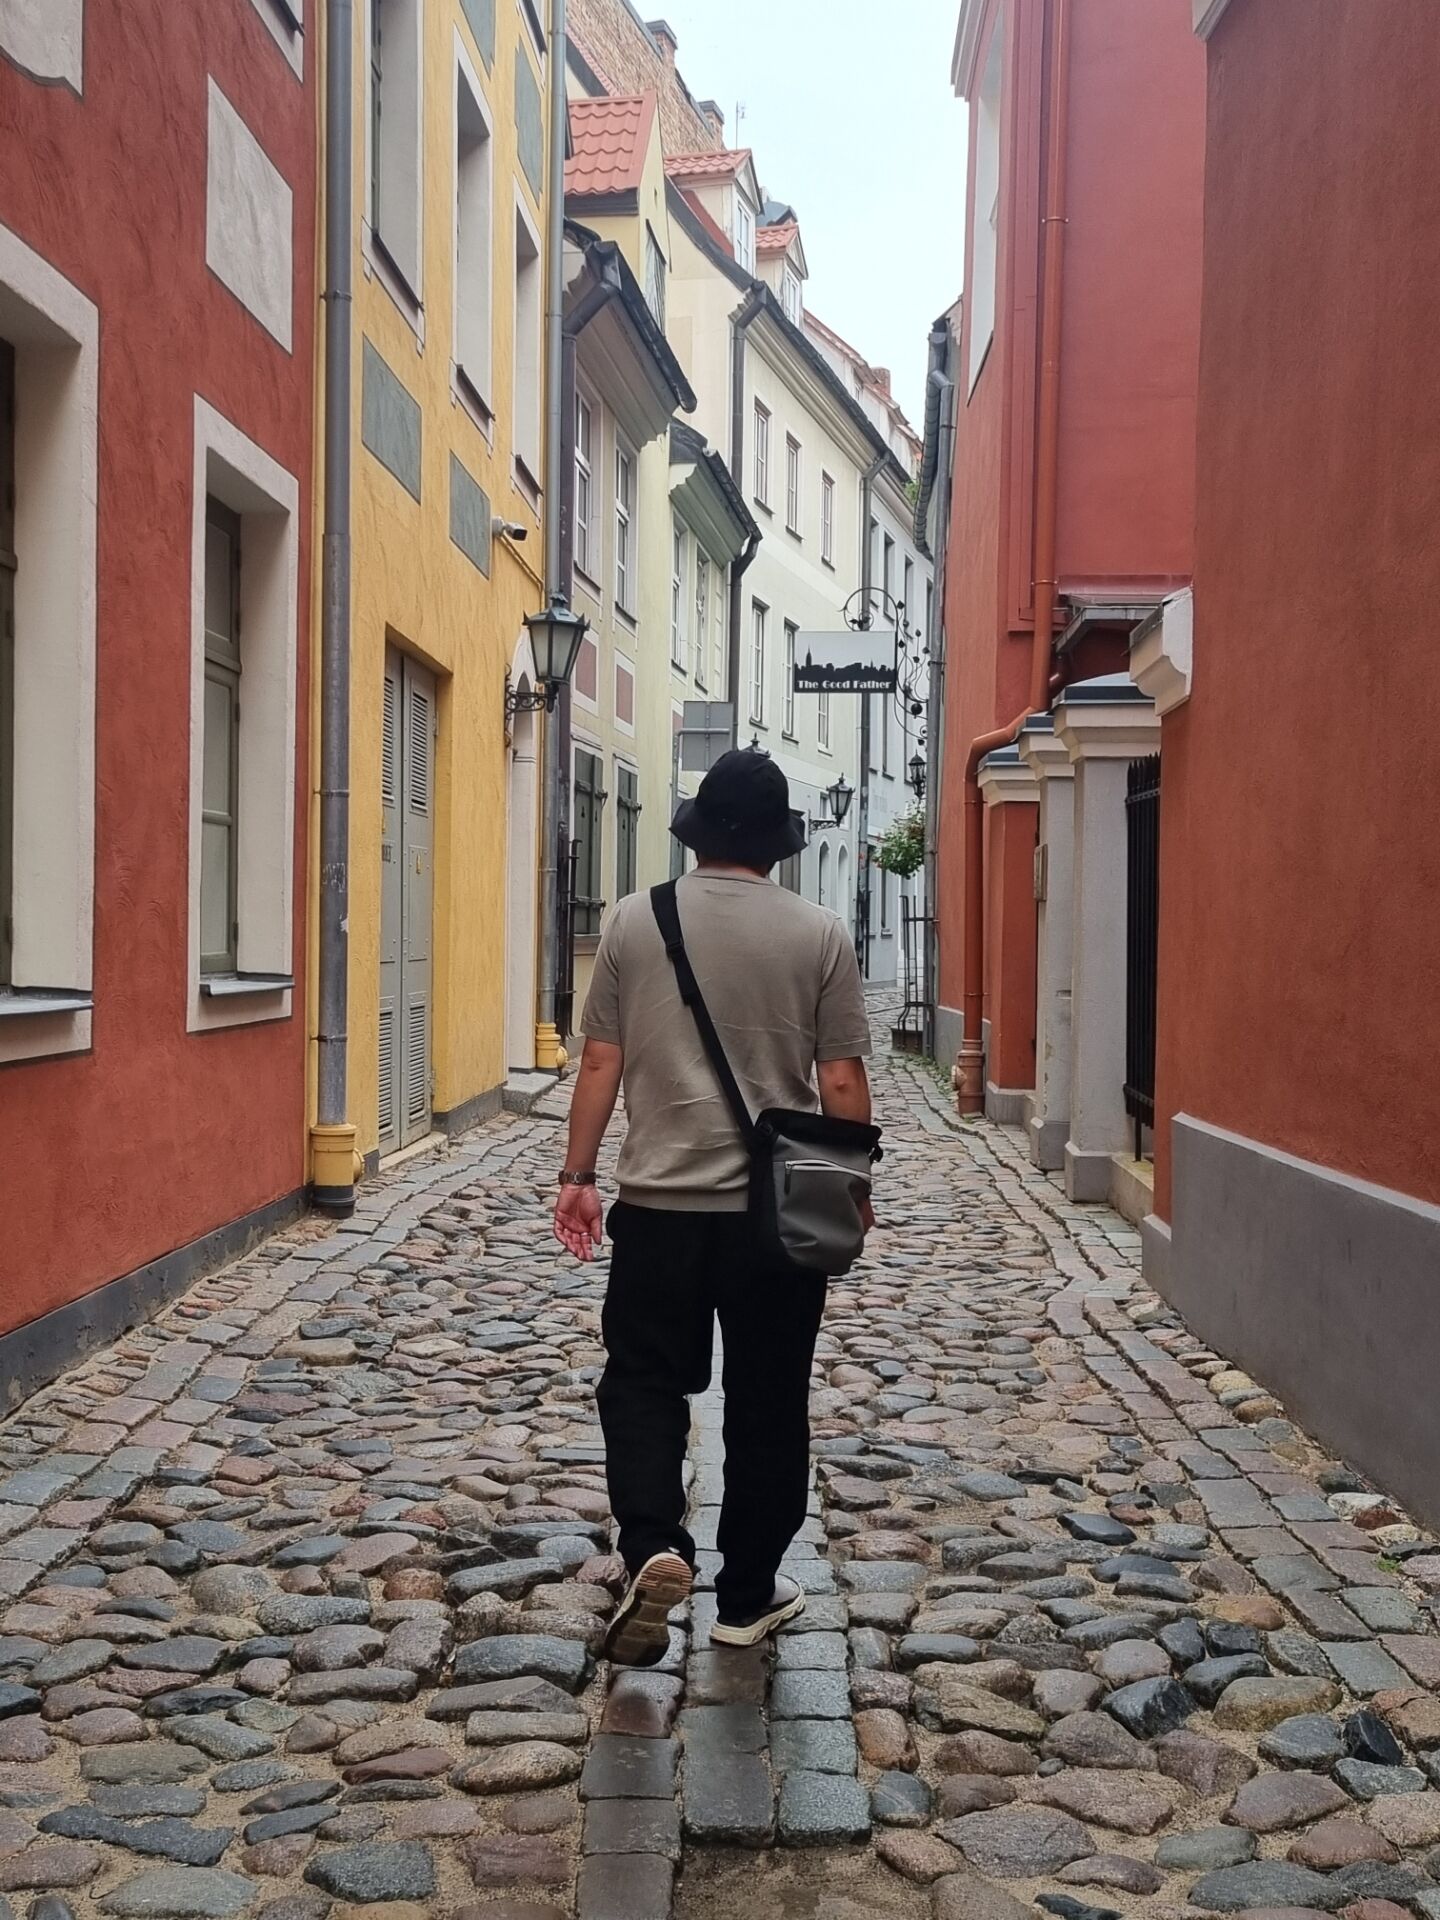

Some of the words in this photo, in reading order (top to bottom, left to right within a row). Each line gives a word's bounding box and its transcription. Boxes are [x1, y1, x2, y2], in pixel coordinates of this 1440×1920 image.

[797, 680, 819, 689] The
[822, 680, 850, 689] Good
[853, 680, 892, 689] Father
